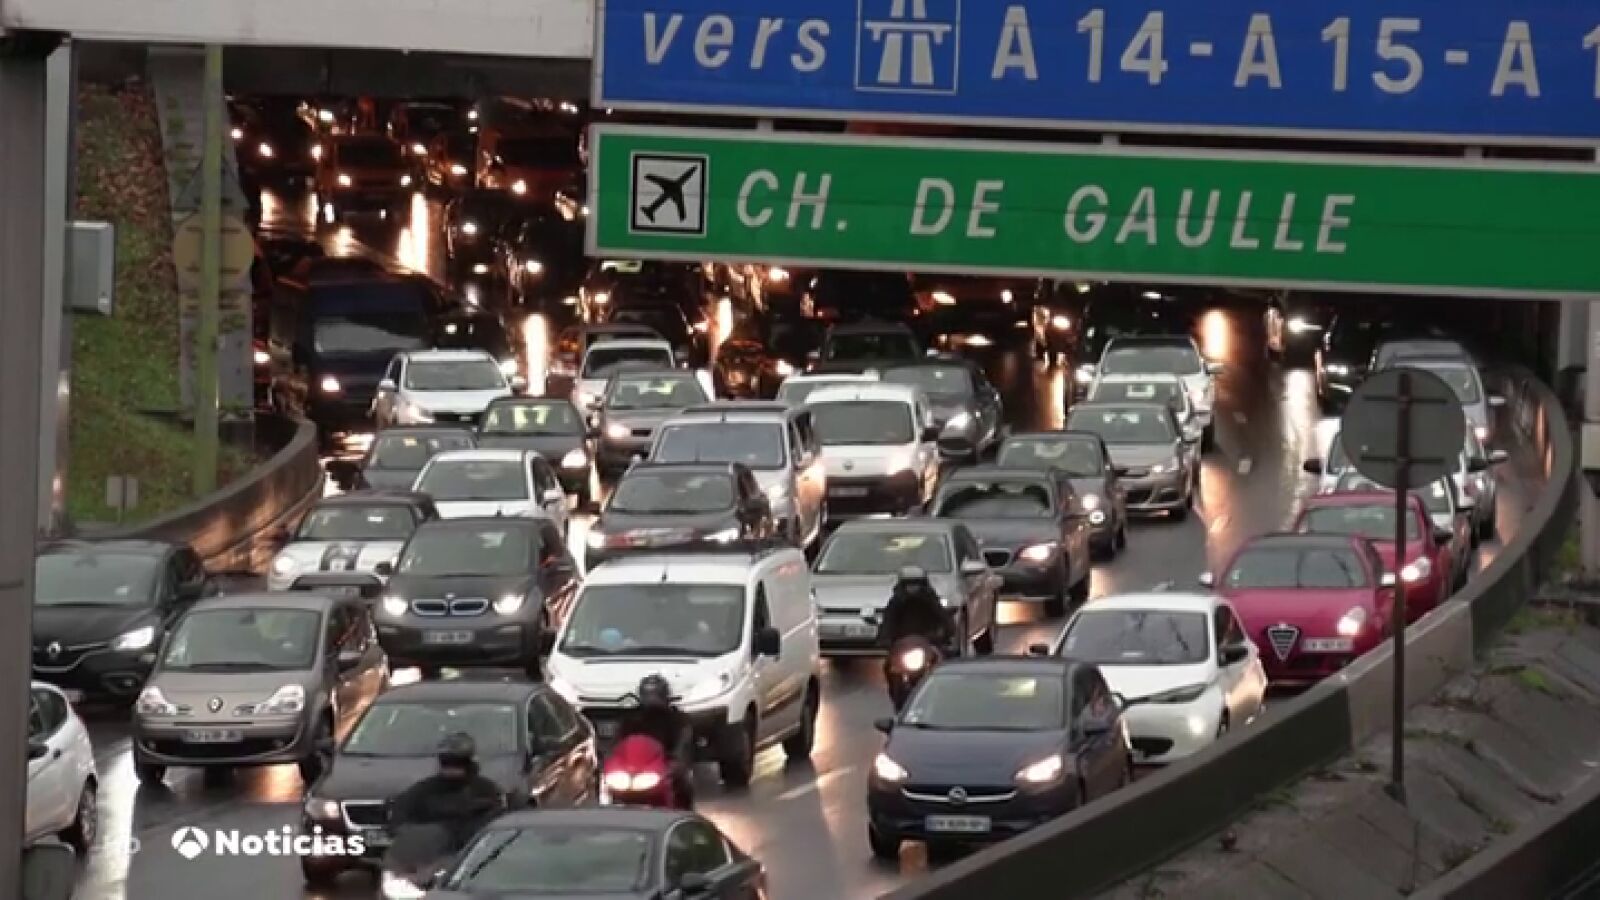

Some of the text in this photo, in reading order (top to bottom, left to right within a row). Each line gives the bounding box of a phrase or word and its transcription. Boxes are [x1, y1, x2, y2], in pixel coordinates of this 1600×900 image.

[643, 12, 830, 72] vers
[737, 170, 1354, 252] CH. DE GAULLE
